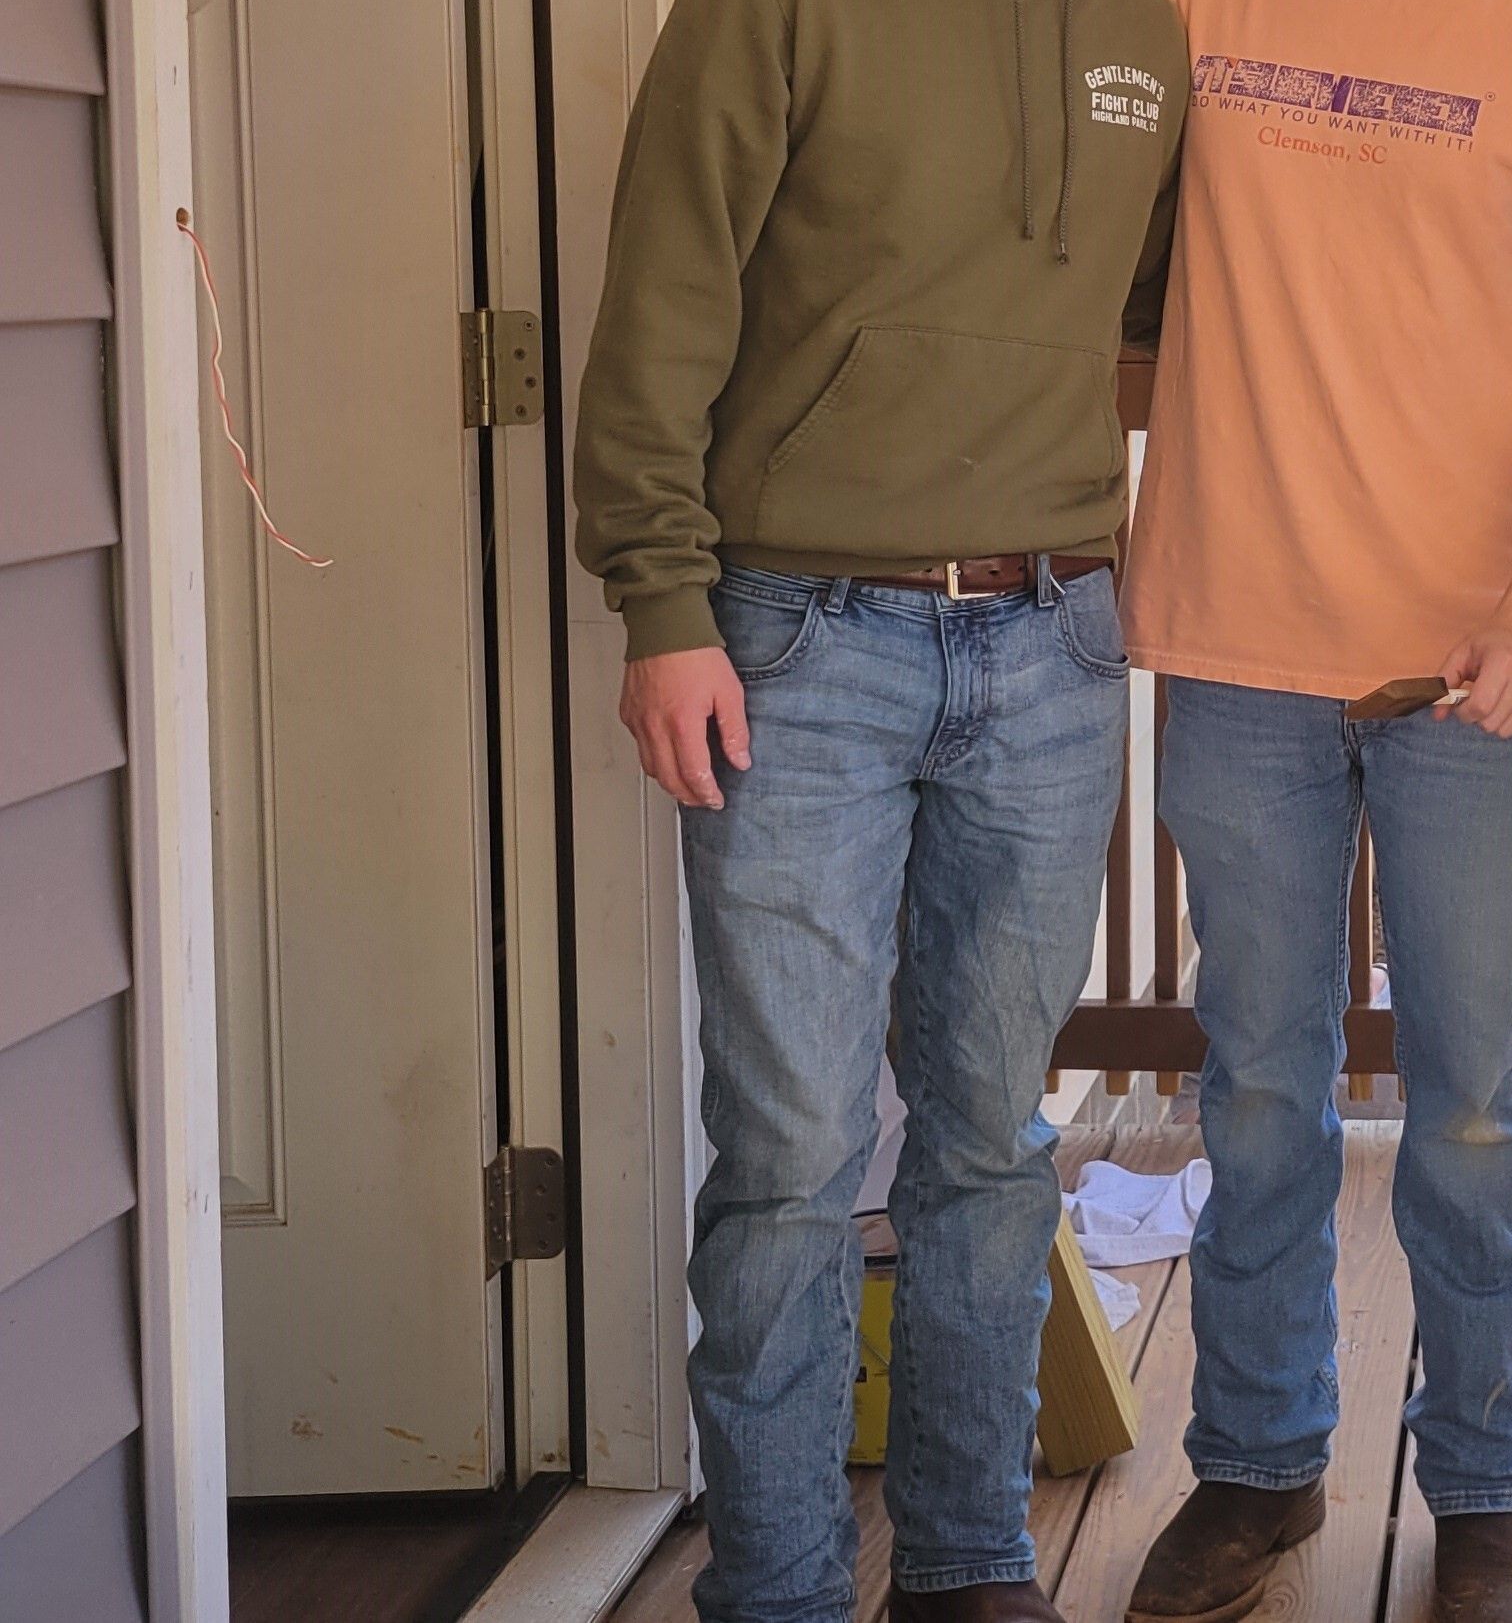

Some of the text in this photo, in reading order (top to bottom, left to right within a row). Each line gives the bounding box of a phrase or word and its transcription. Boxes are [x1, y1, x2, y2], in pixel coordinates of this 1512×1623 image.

[1084, 65, 1166, 102] GENTLEMEN'S
[1091, 91, 1160, 120] FIGHT CLUB
[1091, 109, 1130, 126] HIGHLAND
[1218, 97, 1268, 115] WHAT
[1280, 107, 1318, 125] YOU
[1328, 115, 1377, 137] WANT
[1388, 125, 1436, 146] WITH
[1446, 138, 1474, 153] IT!
[1257, 125, 1388, 165] Clemson, SC
